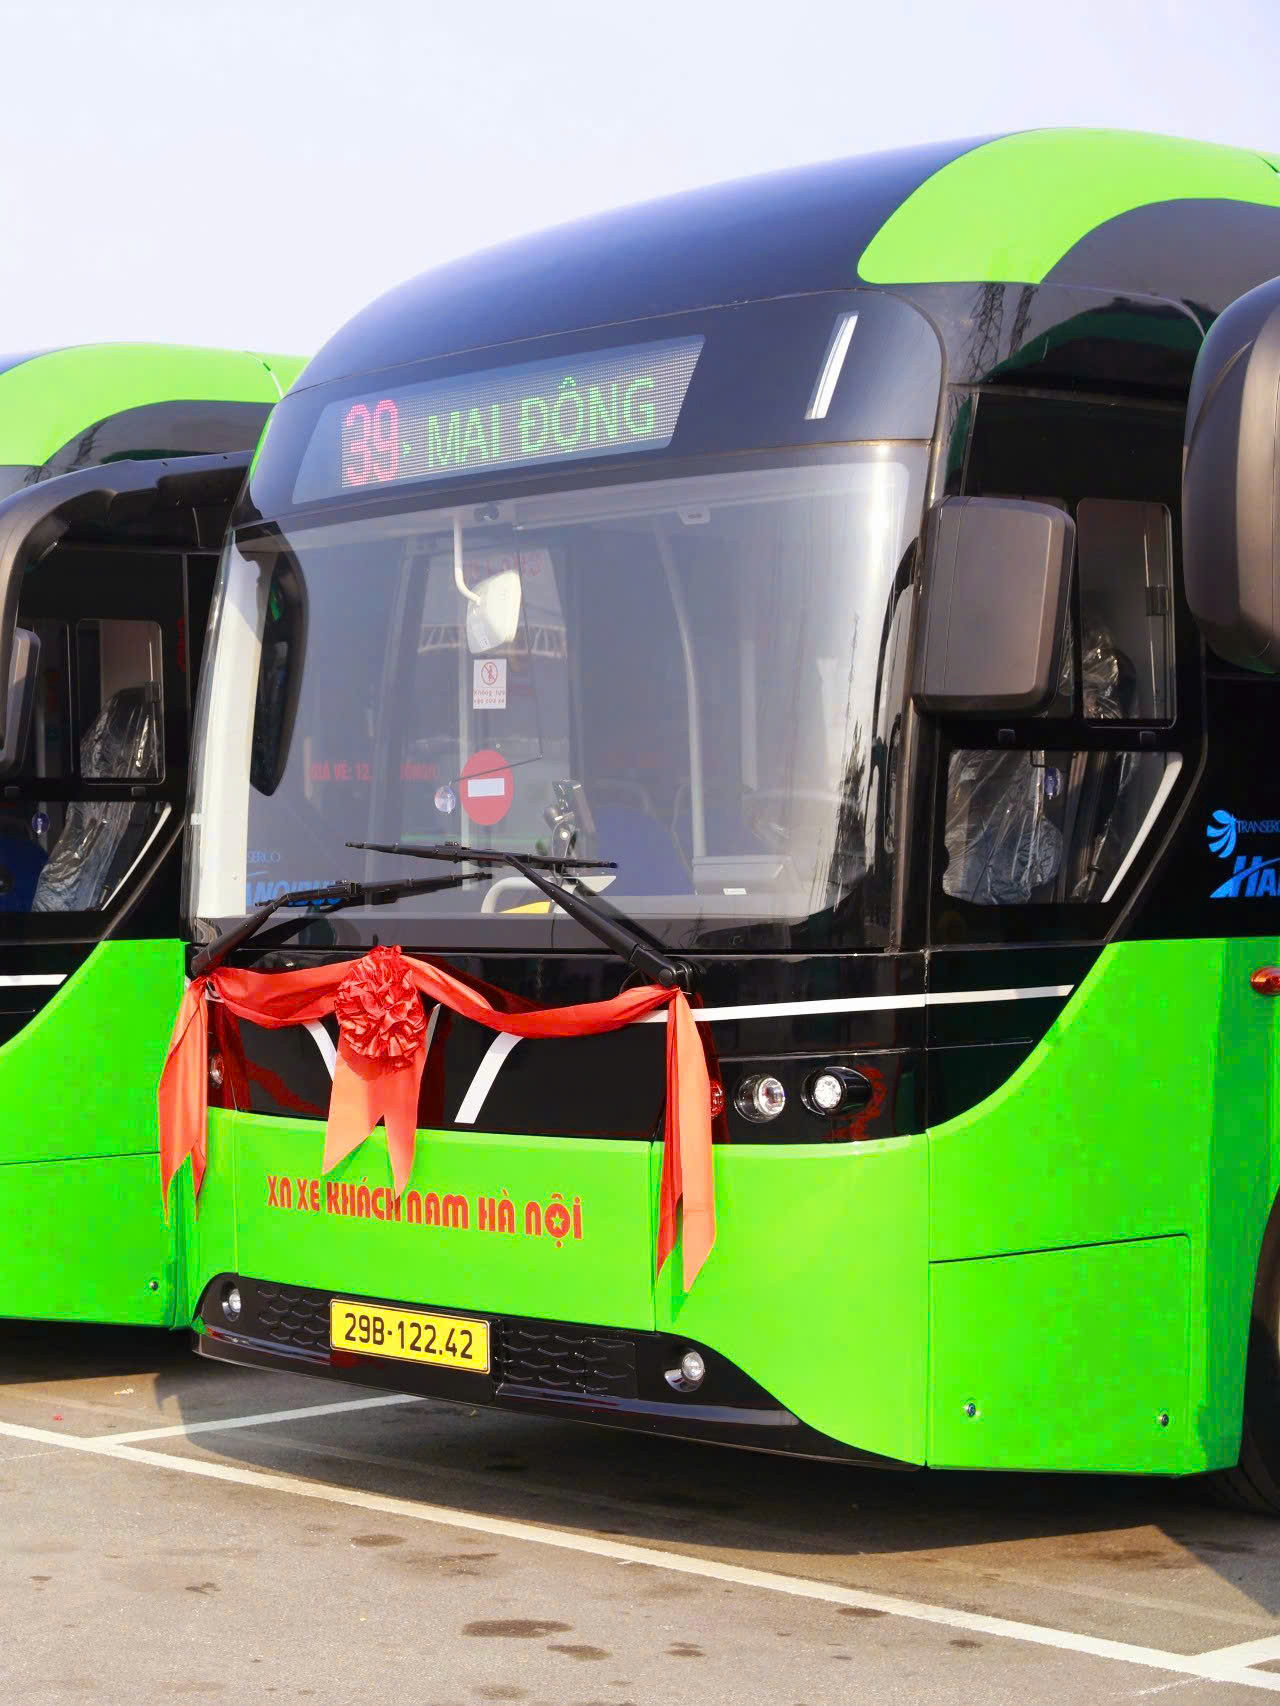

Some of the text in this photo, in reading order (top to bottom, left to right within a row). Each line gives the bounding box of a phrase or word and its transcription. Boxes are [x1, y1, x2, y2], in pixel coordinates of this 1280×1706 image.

[345, 376, 655, 486] 39 MAI ĐÔNG
[297, 1178, 320, 1212] XE
[326, 1176, 402, 1222] KHÁCH
[406, 1190, 469, 1230] NAM
[477, 1188, 516, 1235] HÀ
[524, 1192, 583, 1249] NỘI
[344, 1312, 473, 1360] 29B-122.42
